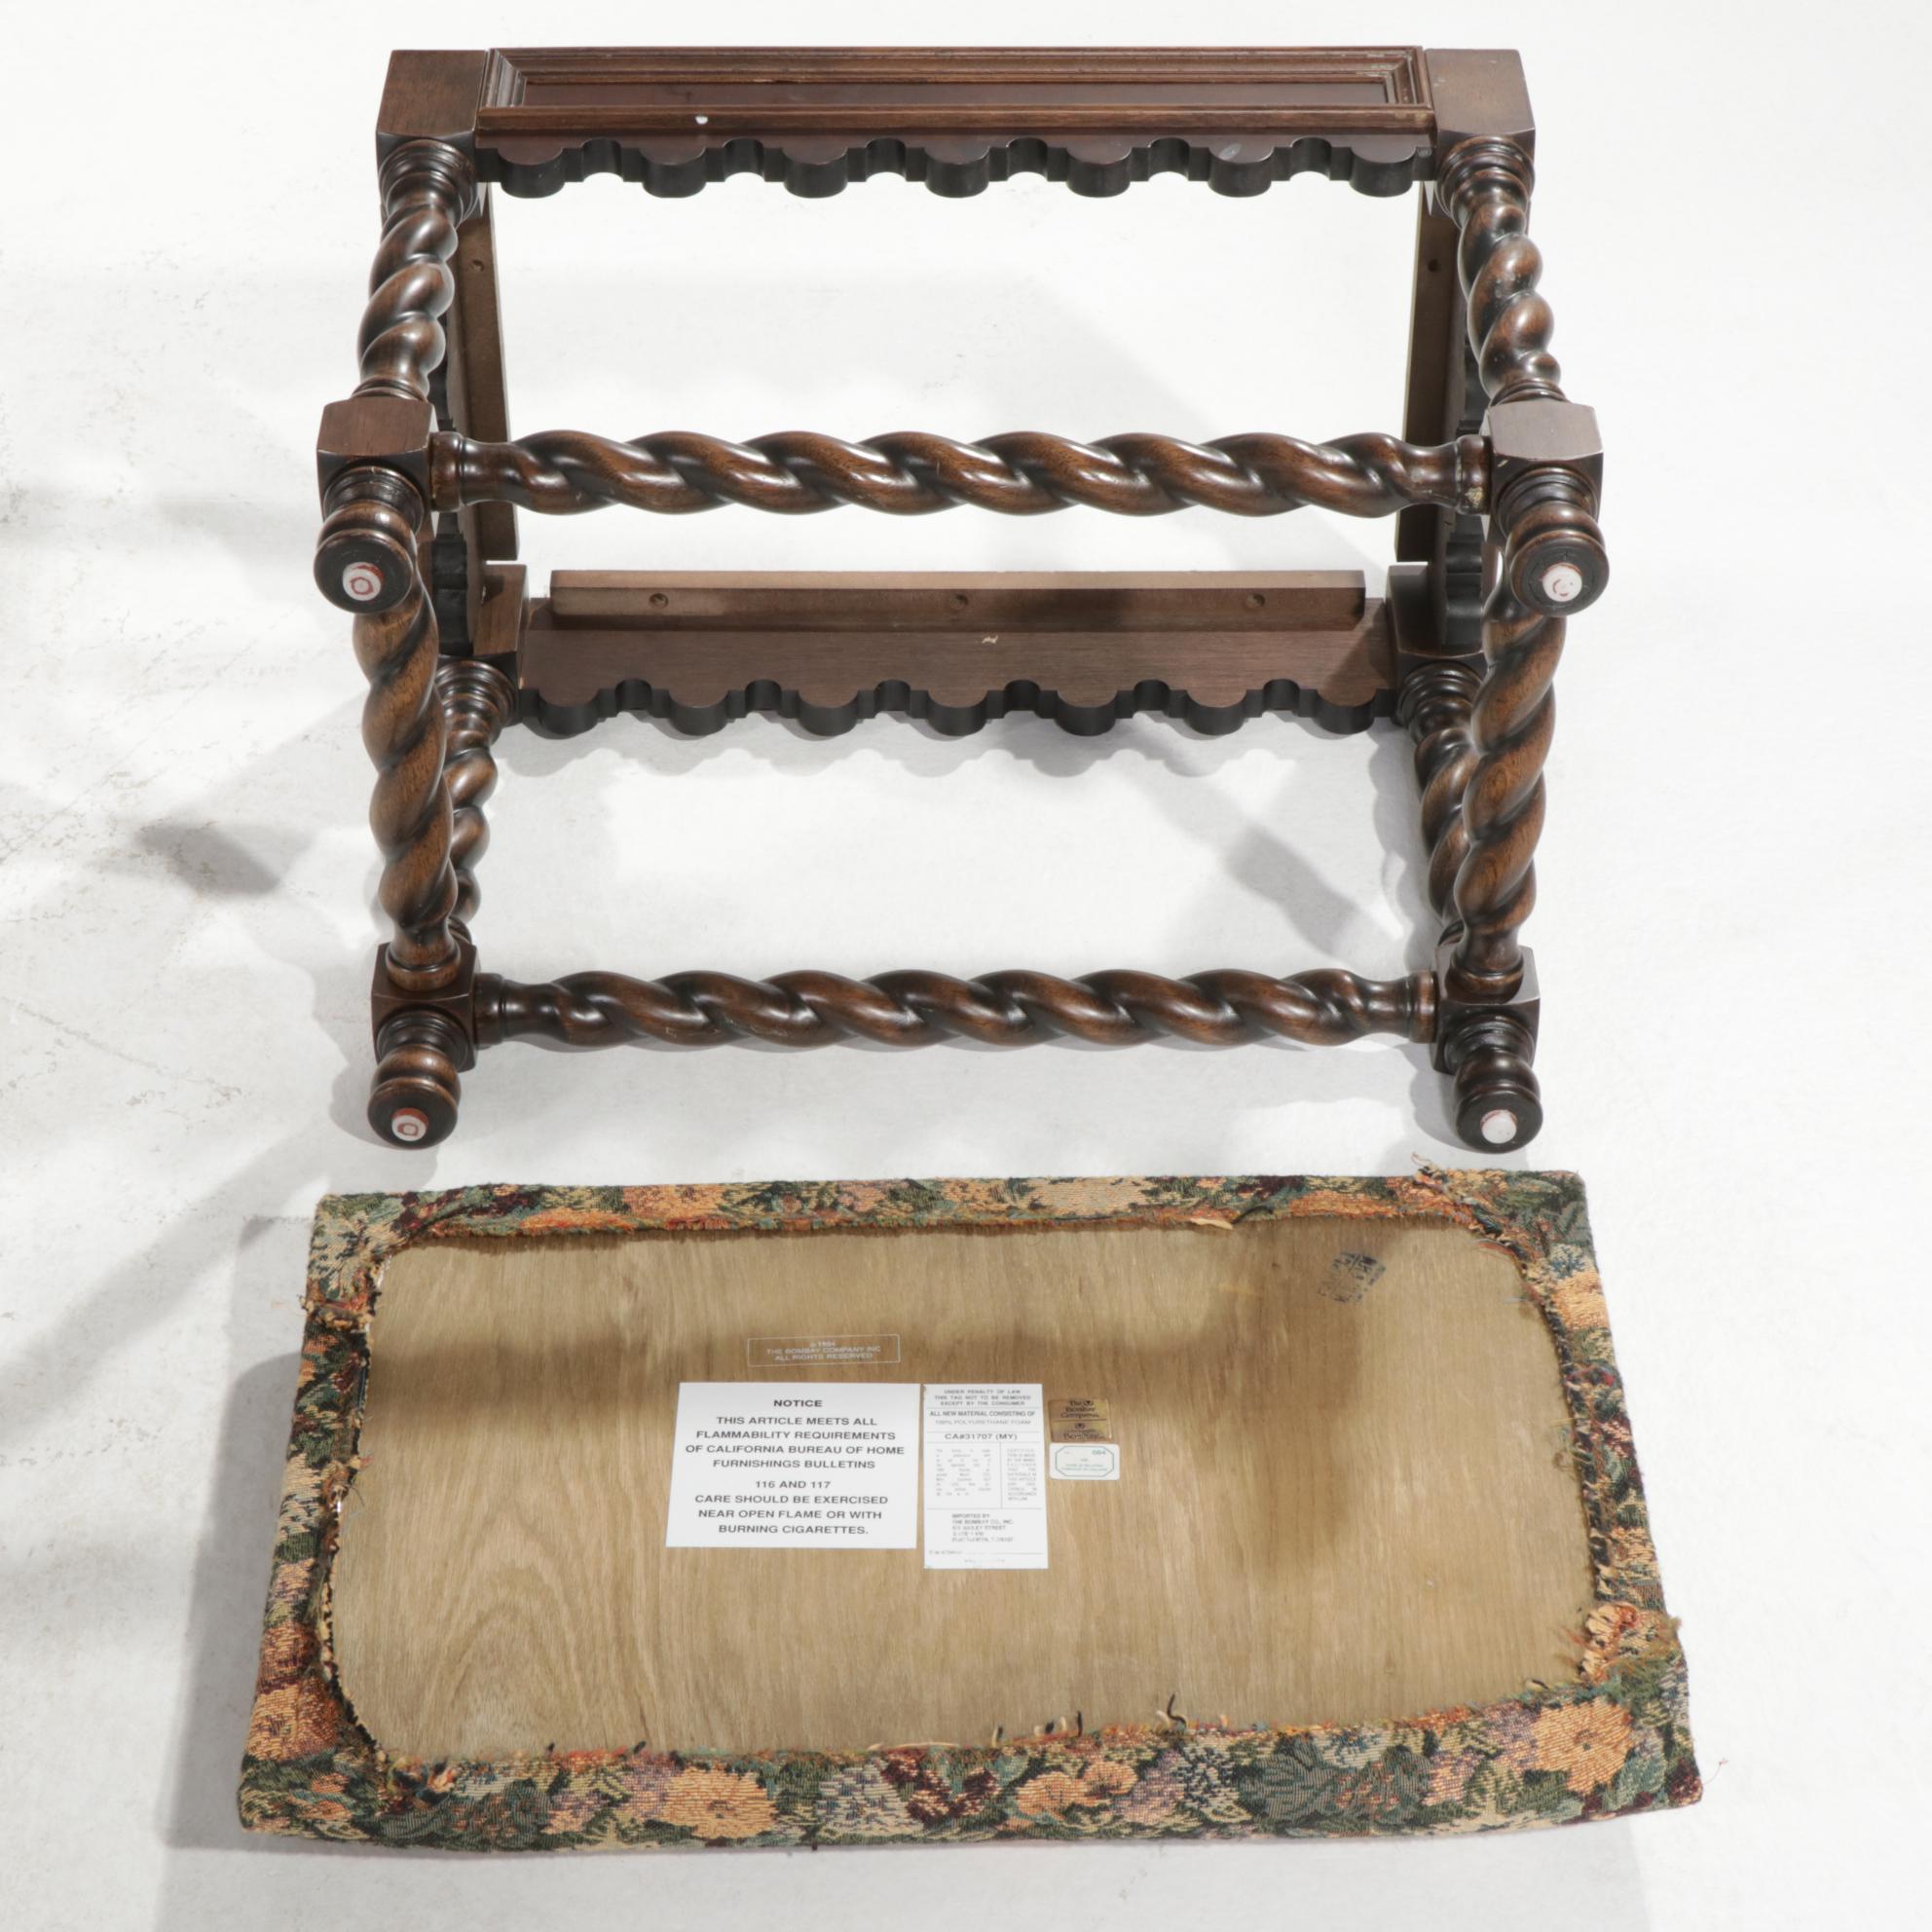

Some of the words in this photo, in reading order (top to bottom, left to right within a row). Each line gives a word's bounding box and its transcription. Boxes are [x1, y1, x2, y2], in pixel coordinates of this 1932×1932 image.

[773, 1399, 823, 1408] NOTICE
[748, 1417, 803, 1426] ARTICLE
[806, 1417, 850, 1426] MEETS
[695, 1430, 791, 1439] FLAMMABILITY
[795, 1431, 896, 1440] REQUIREMENTS
[706, 1445, 784, 1454] CALIFORNIA
[867, 1446, 905, 1455] HOME
[713, 1460, 800, 1468] FURNISHINGS
[804, 1460, 875, 1468] BULLETINS
[694, 1495, 731, 1504] CARE
[734, 1495, 789, 1504] SHOULD
[814, 1496, 888, 1505] EXERCISED
[698, 1509, 734, 1518] NEAR
[782, 1525, 869, 1535] CIGARETTES.
